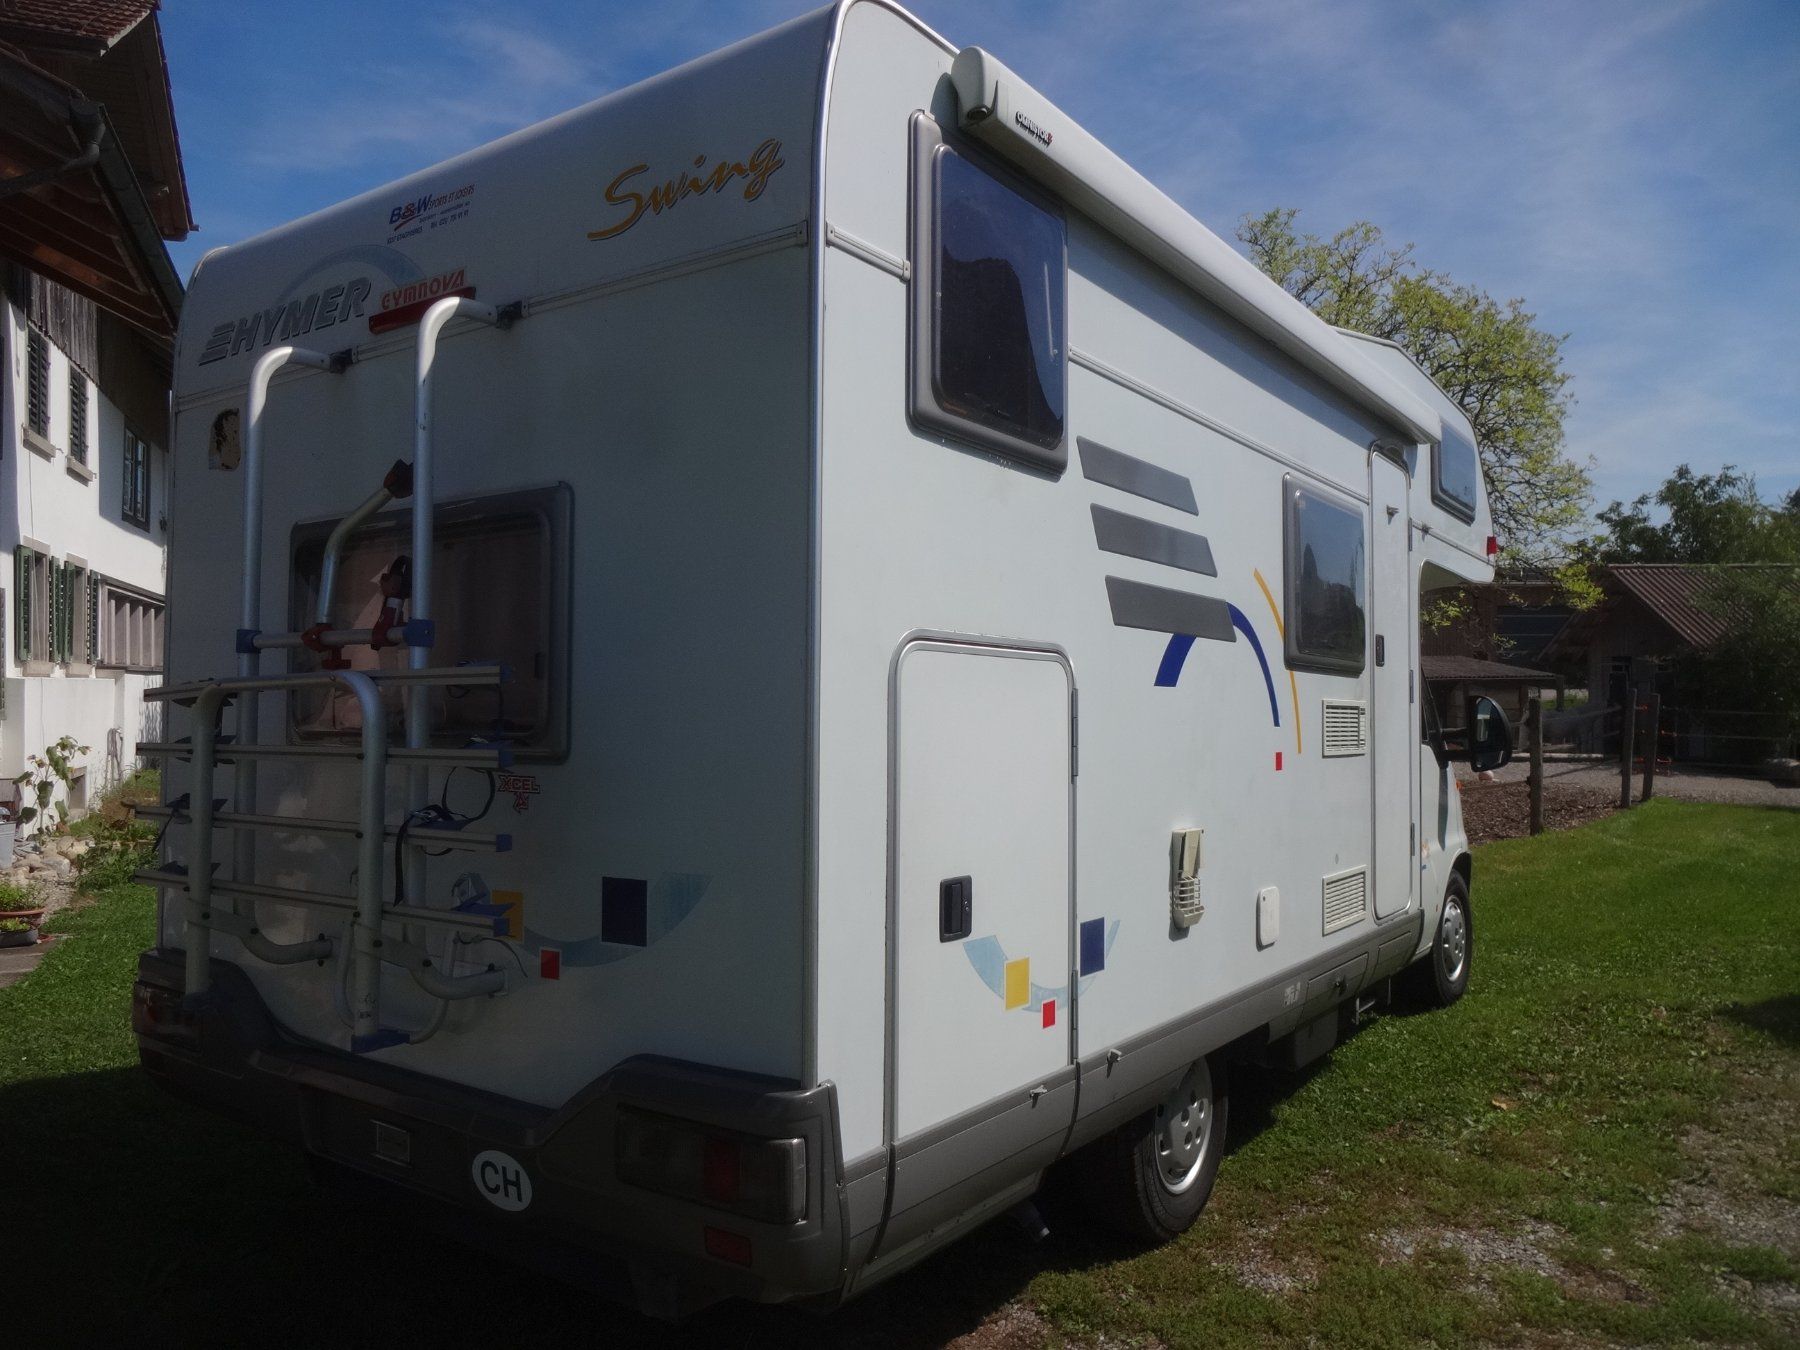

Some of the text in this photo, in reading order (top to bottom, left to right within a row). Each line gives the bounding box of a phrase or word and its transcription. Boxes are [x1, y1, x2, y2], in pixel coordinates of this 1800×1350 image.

[389, 194, 433, 224] B&W
[587, 138, 785, 241] Swing
[228, 276, 372, 358] HYMER
[497, 774, 541, 795] XCEL
[480, 1160, 523, 1202] CH
